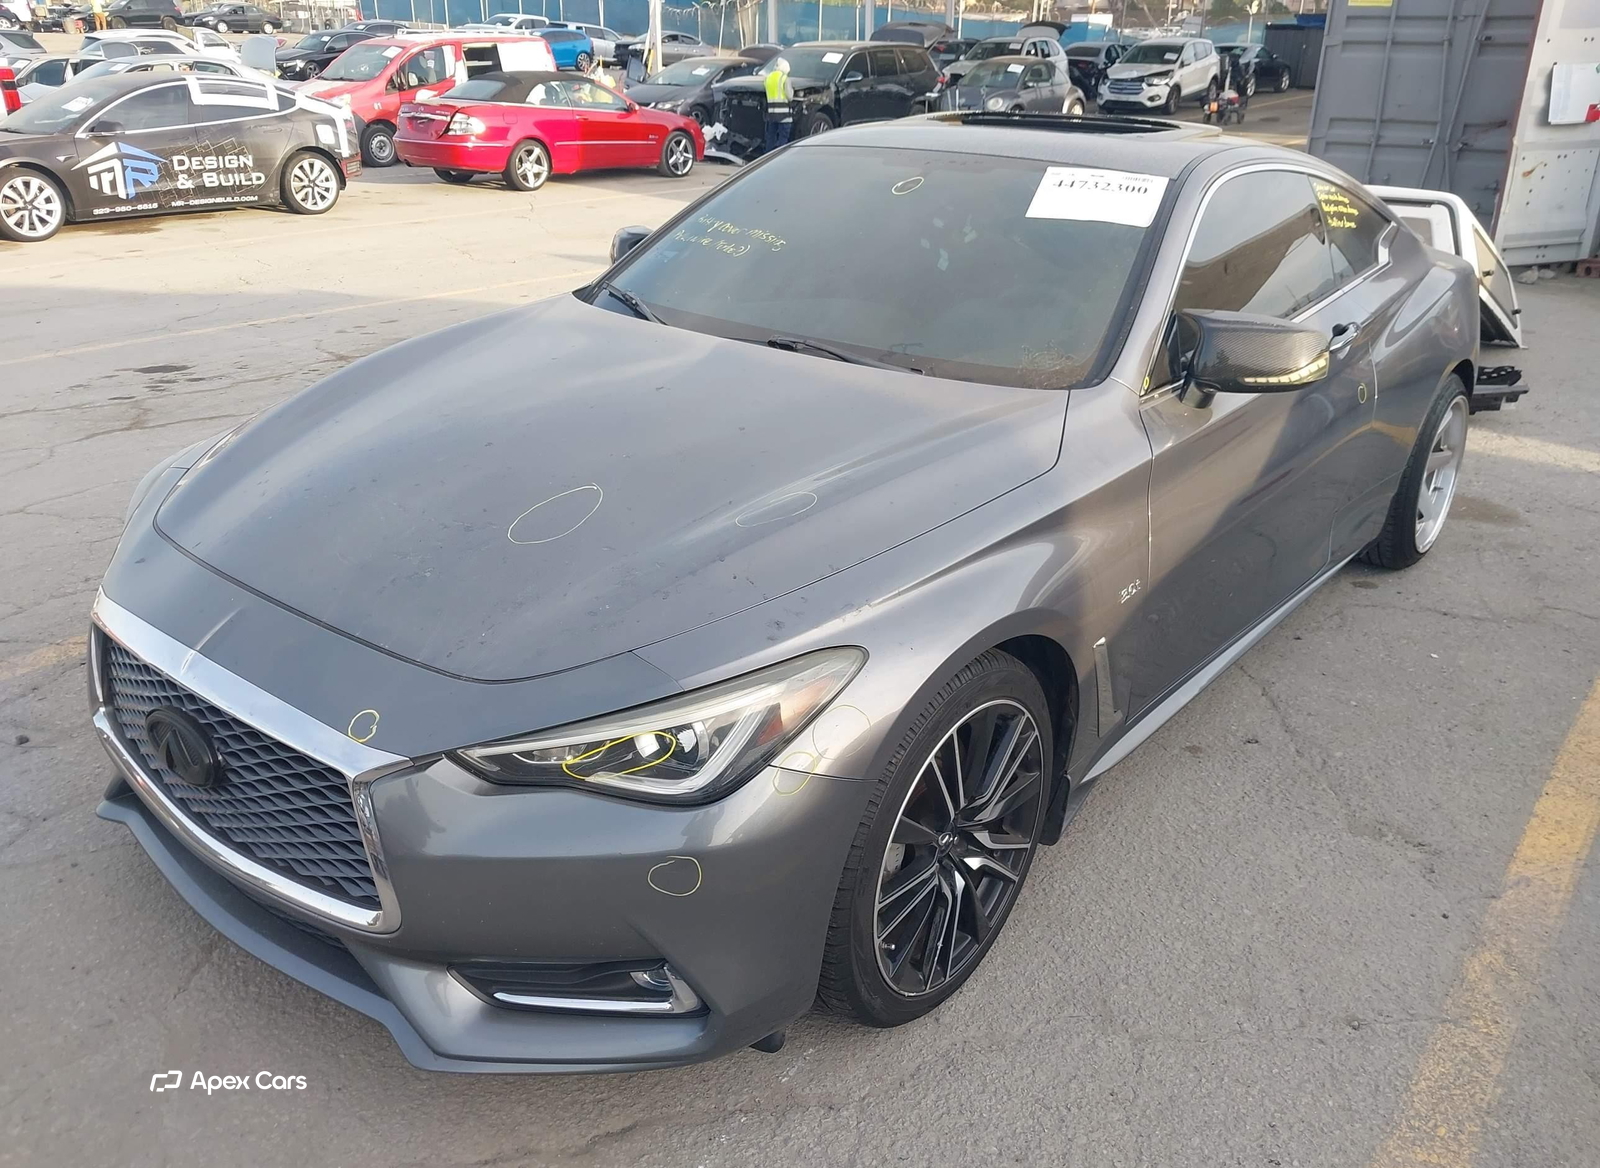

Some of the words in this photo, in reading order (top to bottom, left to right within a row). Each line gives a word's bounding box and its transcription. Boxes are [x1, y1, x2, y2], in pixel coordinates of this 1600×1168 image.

[172, 154, 253, 171] DESIGN
[177, 175, 194, 189] &
[203, 172, 266, 188] BUILD
[1053, 179, 1148, 194] 44732300
